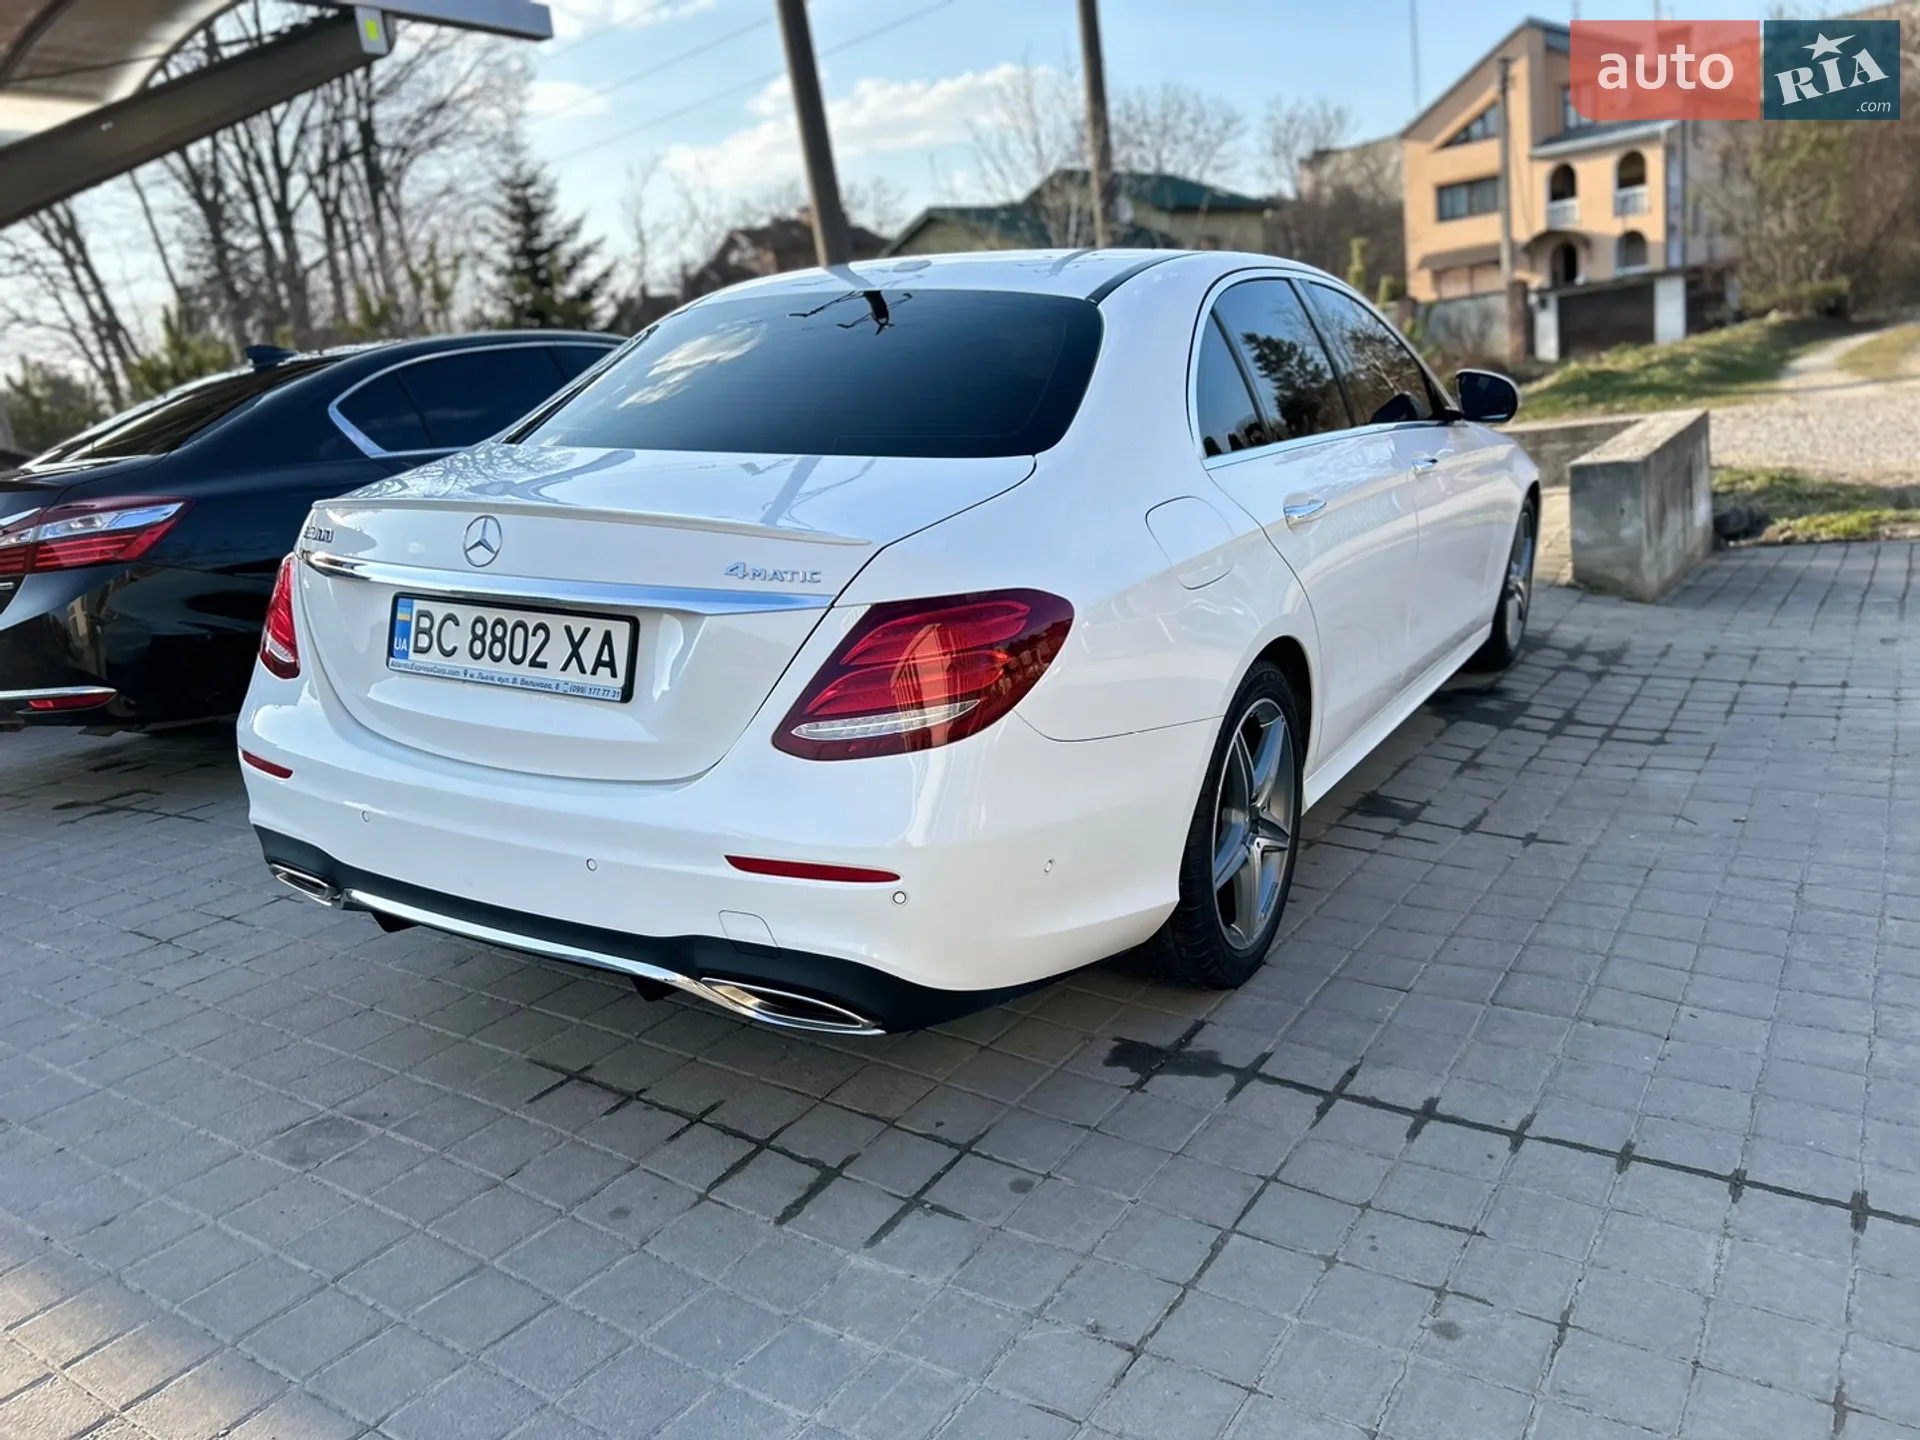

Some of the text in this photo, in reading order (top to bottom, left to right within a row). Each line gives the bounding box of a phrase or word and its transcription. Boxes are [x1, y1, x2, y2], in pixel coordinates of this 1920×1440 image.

[724, 562, 822, 584] 4MATIC
[393, 637, 408, 651] UA
[412, 609, 619, 679] BC 8802 XA
[588, 687, 600, 696] 177
[601, 688, 611, 697] 77
